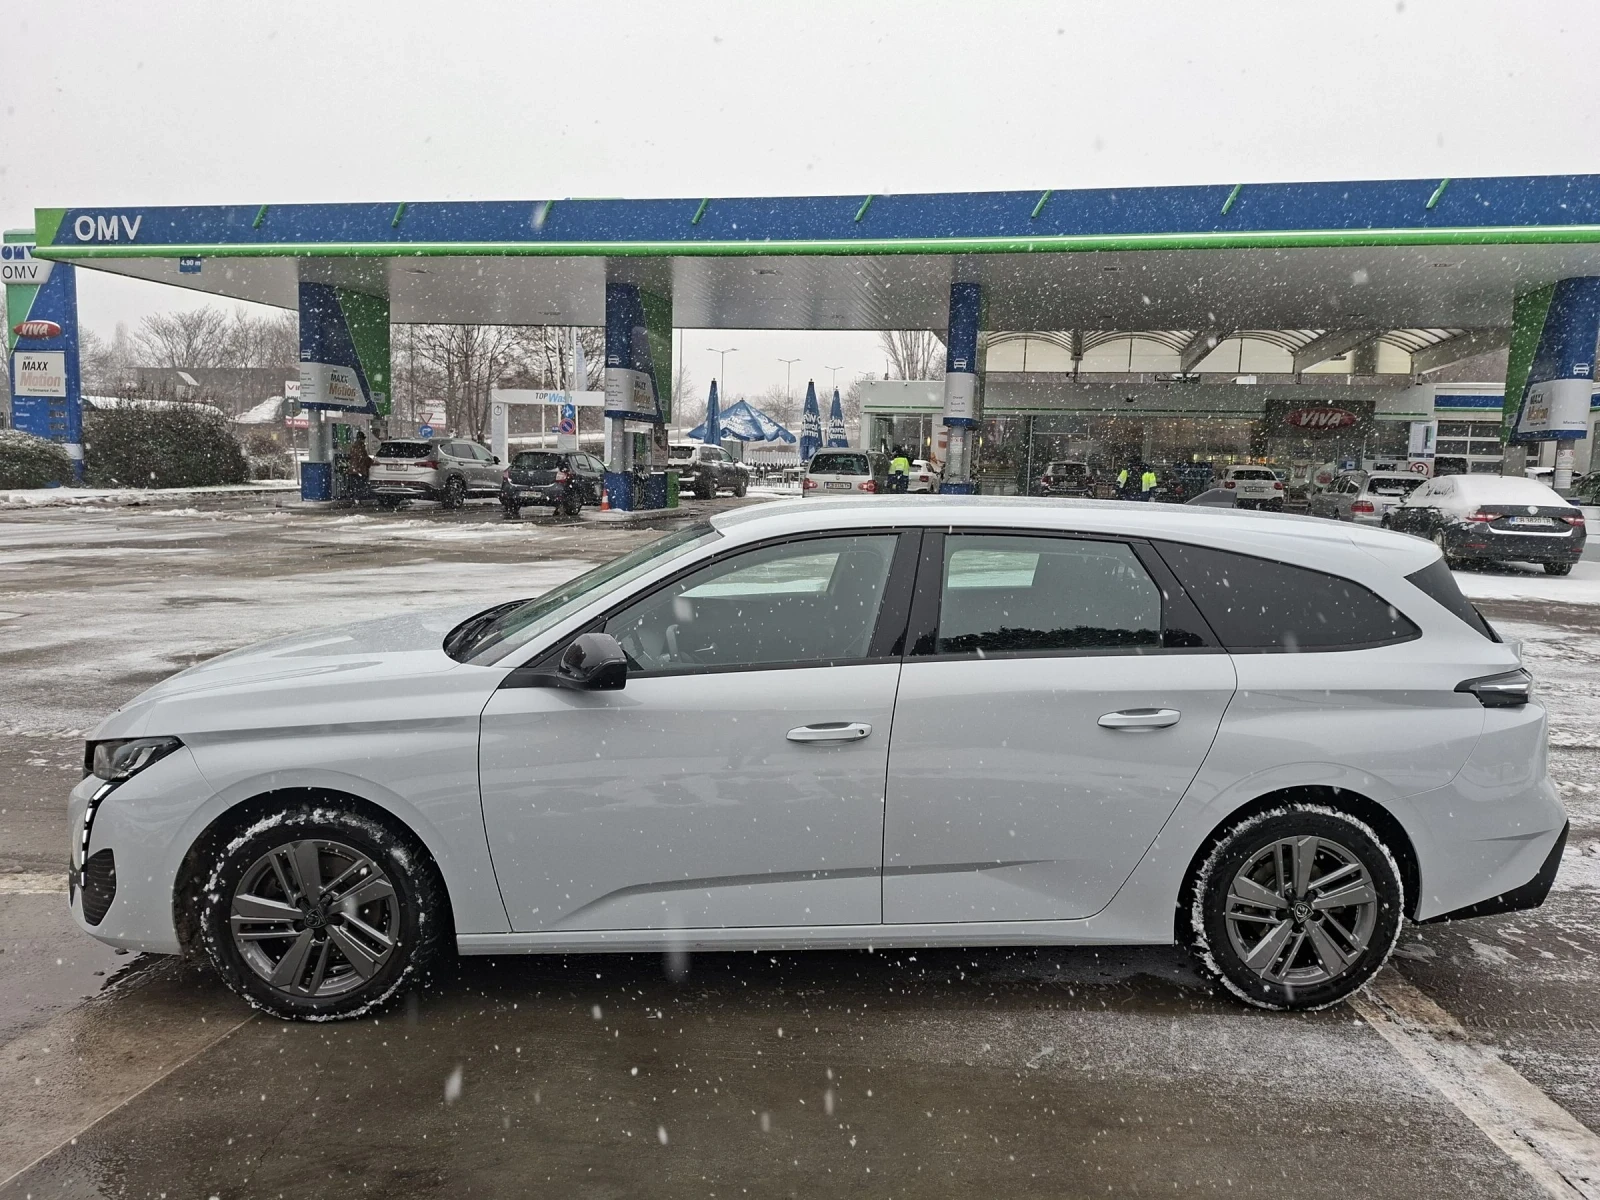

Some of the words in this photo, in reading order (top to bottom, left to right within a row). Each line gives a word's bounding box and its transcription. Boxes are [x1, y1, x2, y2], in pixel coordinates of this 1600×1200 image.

[75, 215, 142, 241] OMV
[2, 265, 38, 279] OMV
[22, 323, 49, 335] VIVA
[22, 361, 48, 371] MAXX
[20, 372, 61, 387] Motion
[535, 392, 548, 400] TOP
[1300, 412, 1341, 426] VIVA
